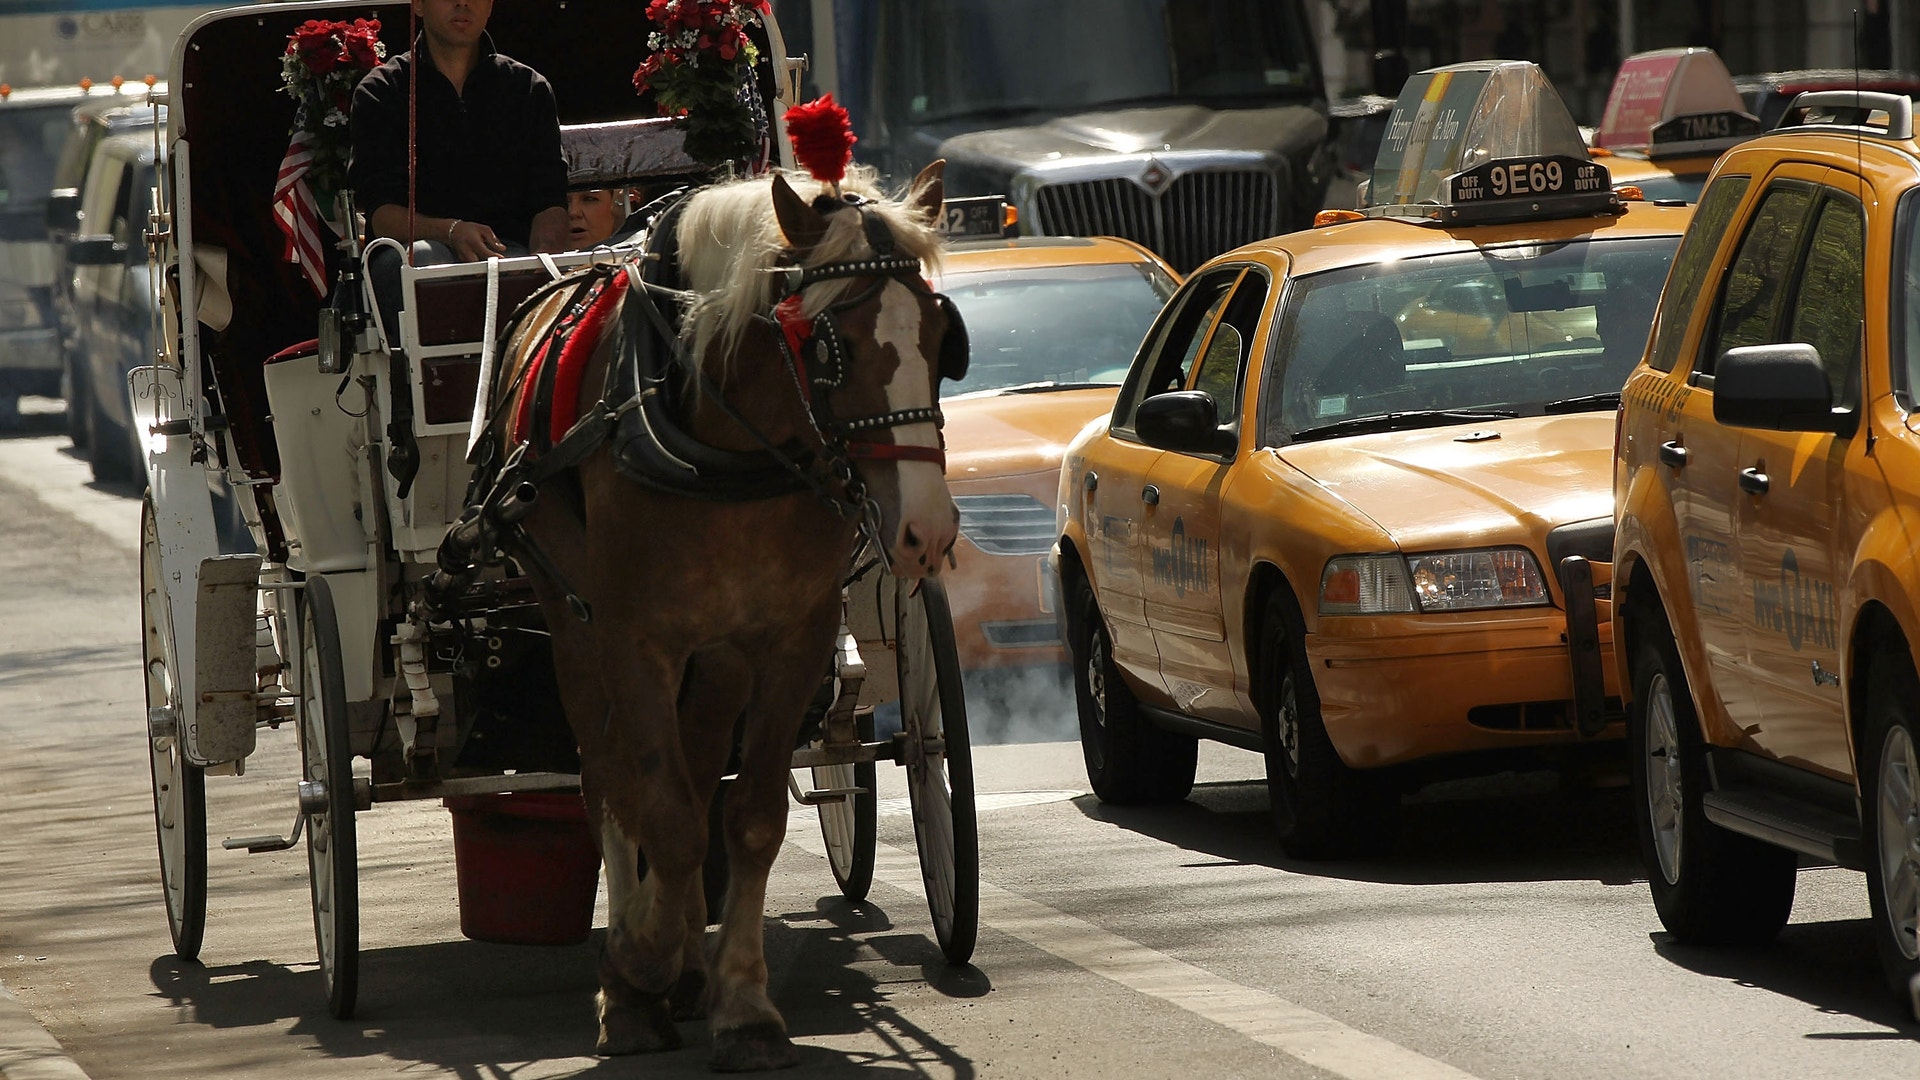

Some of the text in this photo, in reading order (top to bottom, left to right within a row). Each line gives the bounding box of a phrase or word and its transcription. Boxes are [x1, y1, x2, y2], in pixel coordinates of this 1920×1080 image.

[1388, 108, 1412, 152] Happy
[1440, 109, 1459, 152] Mayo
[1682, 115, 1730, 139] 7M43
[1491, 161, 1563, 196] 9E69
[1578, 166, 1595, 178] OFF
[1461, 176, 1479, 188] OFF
[1574, 178, 1600, 191] DUTY
[1458, 187, 1484, 200] DUTY
